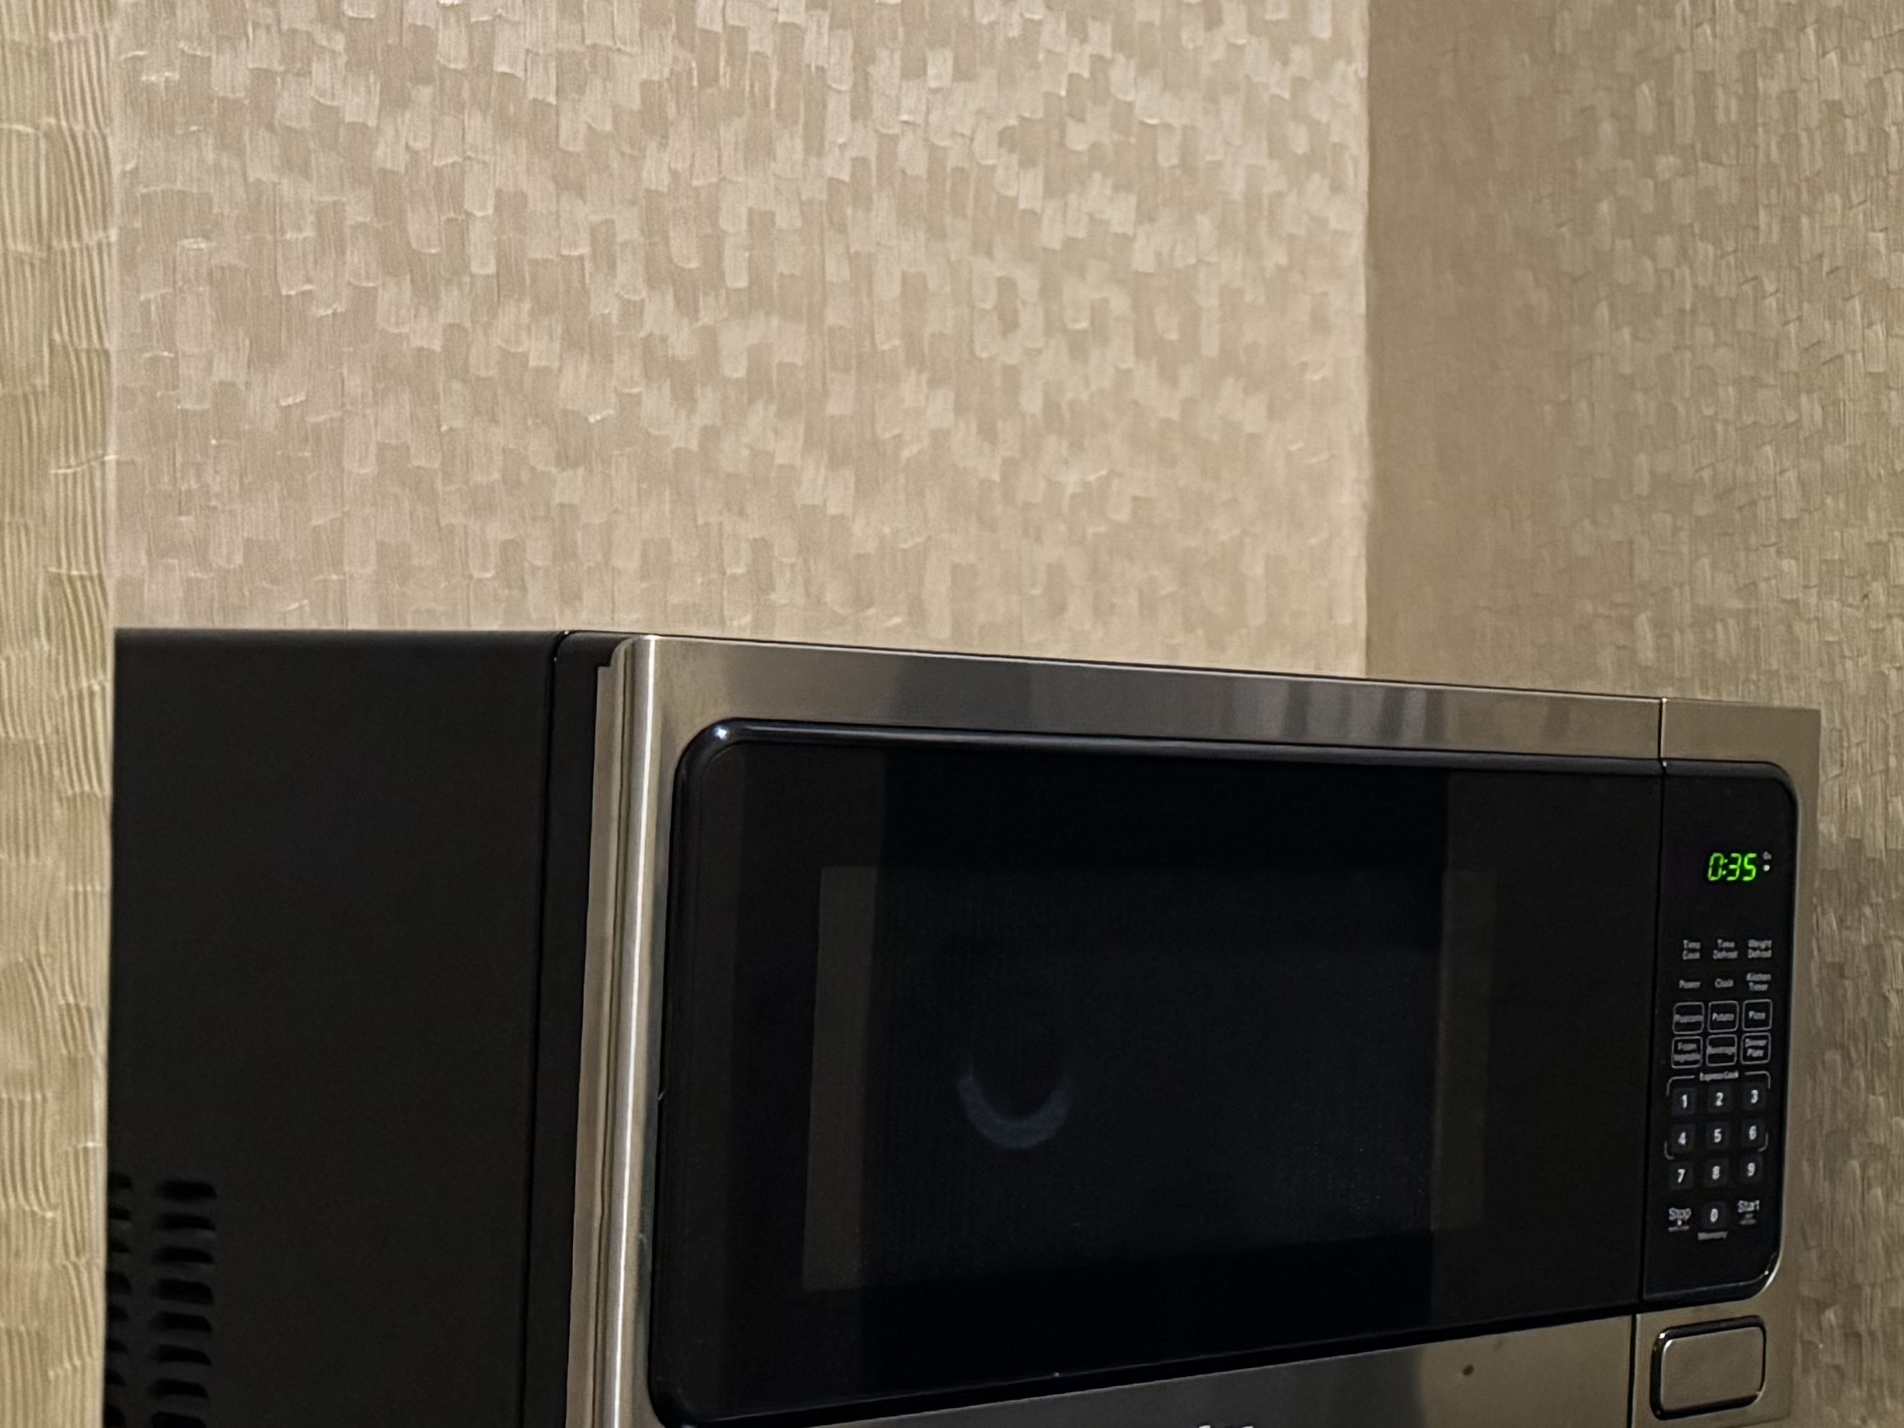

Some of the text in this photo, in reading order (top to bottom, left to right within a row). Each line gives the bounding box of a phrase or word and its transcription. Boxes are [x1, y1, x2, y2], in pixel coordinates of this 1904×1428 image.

[1707, 852, 1758, 882] 0:35
[1681, 1088, 1760, 1109] 1 2 3
[1677, 1124, 1758, 1146] 4 5 6
[1677, 1168, 1687, 1183] 7
[1746, 1162, 1756, 1177] 9
[1710, 1208, 1719, 1223] 0
